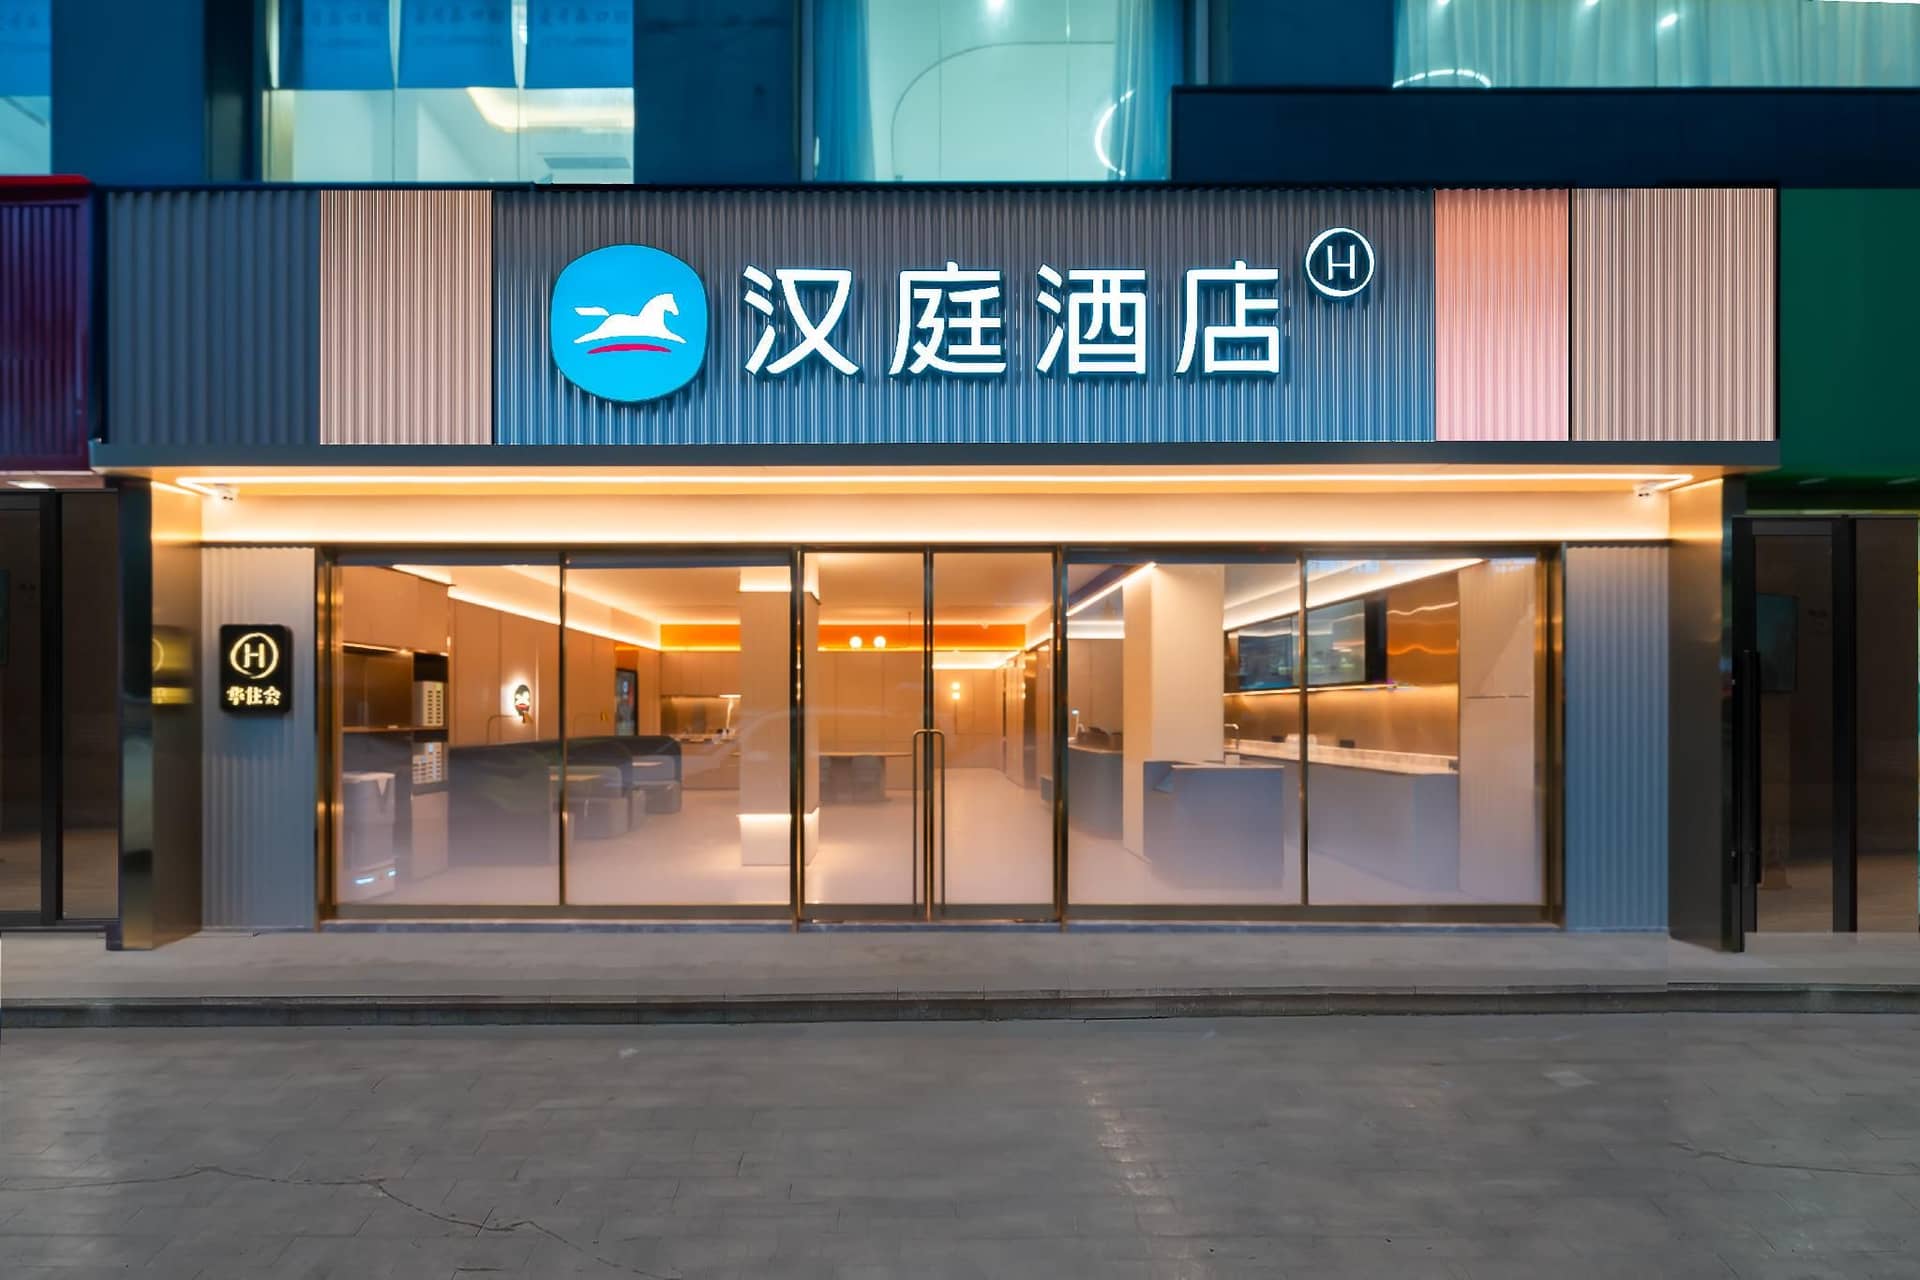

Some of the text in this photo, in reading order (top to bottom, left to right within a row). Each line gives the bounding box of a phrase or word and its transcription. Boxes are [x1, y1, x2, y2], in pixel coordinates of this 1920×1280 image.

[743, 260, 1280, 376] 汉庭酒店
[226, 685, 282, 706] 华住会
